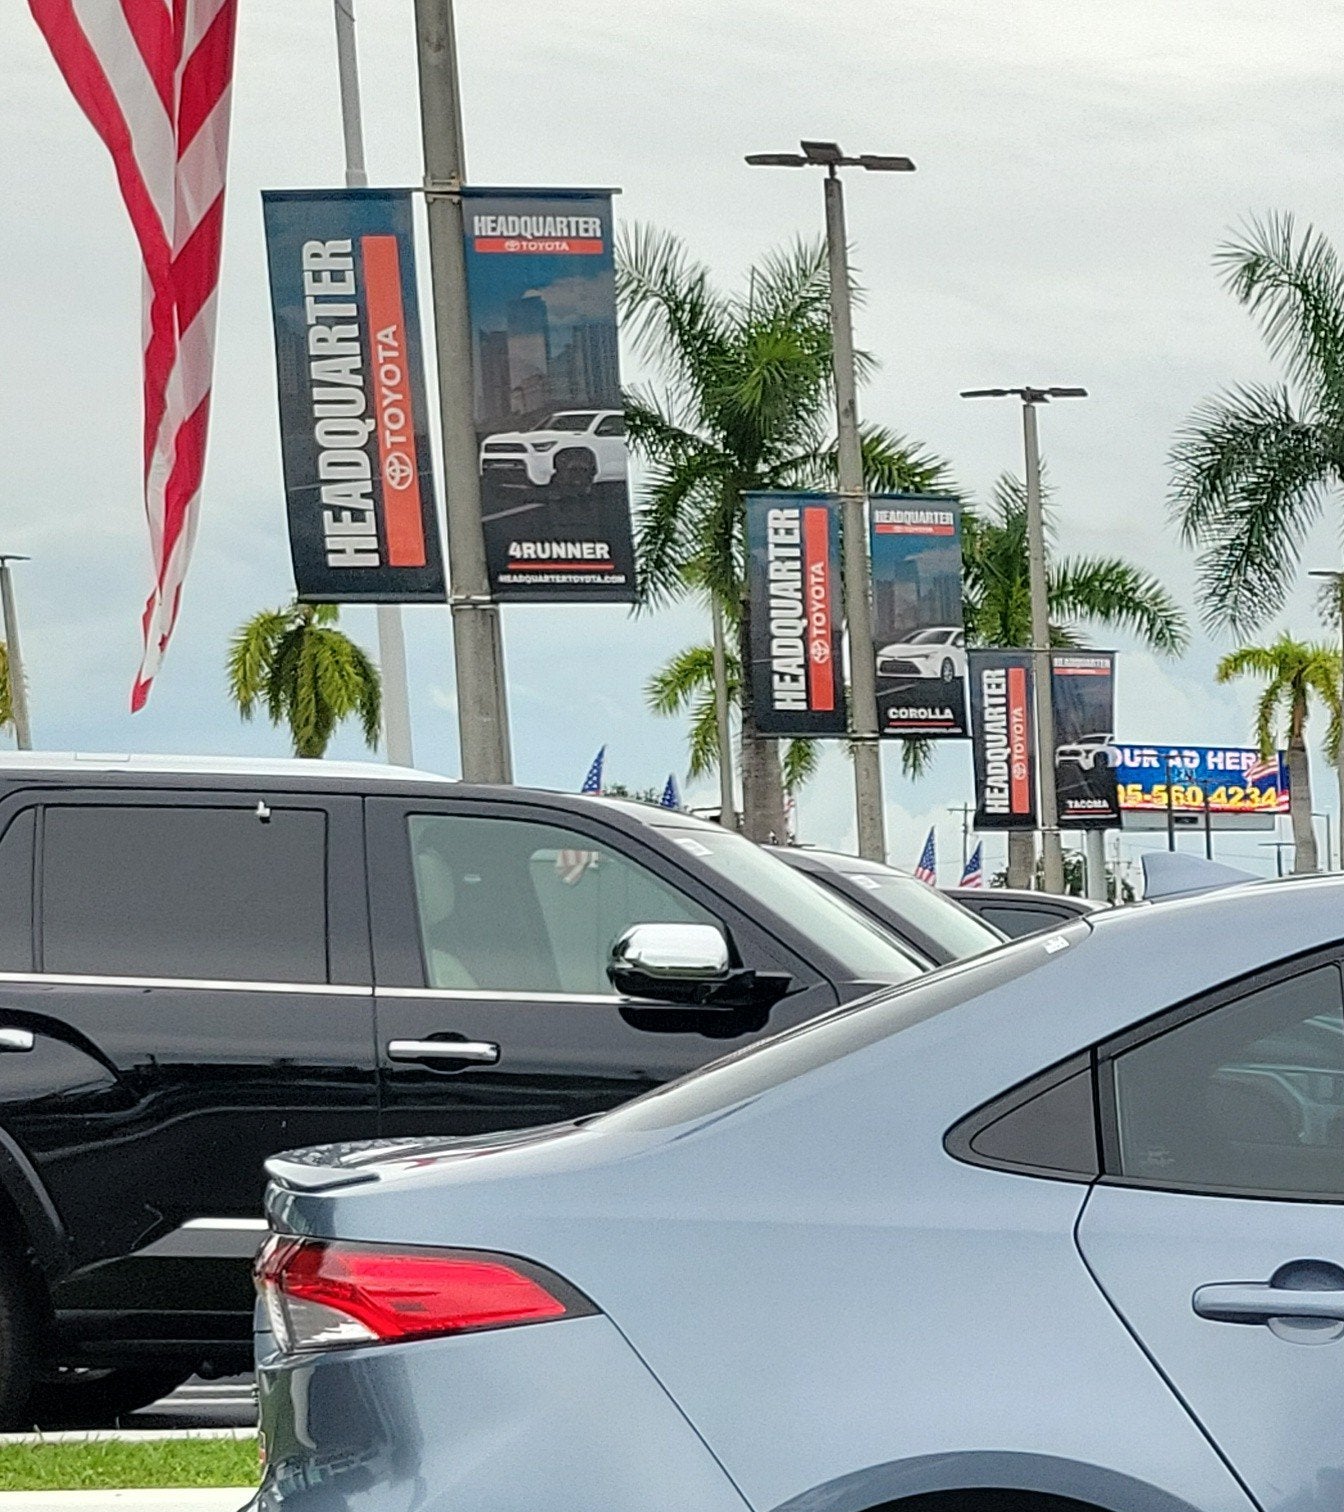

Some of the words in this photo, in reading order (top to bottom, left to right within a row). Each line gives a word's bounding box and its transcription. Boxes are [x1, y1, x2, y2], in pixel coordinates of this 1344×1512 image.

[473, 215, 602, 239] HEADQUARTER
[520, 241, 570, 252] TOYOTA
[303, 238, 380, 568] HEADQUARTER
[377, 324, 407, 448] TOYOTA
[508, 542, 611, 559] 4RUNNER
[767, 508, 808, 711] HEADQUARTER
[810, 561, 828, 638] TOYOTA
[887, 707, 954, 719] COROLLA
[1012, 707, 1025, 759] TOYOTA
[982, 669, 1011, 814] HEADQUARTER
[1206, 751, 1261, 771] HER
